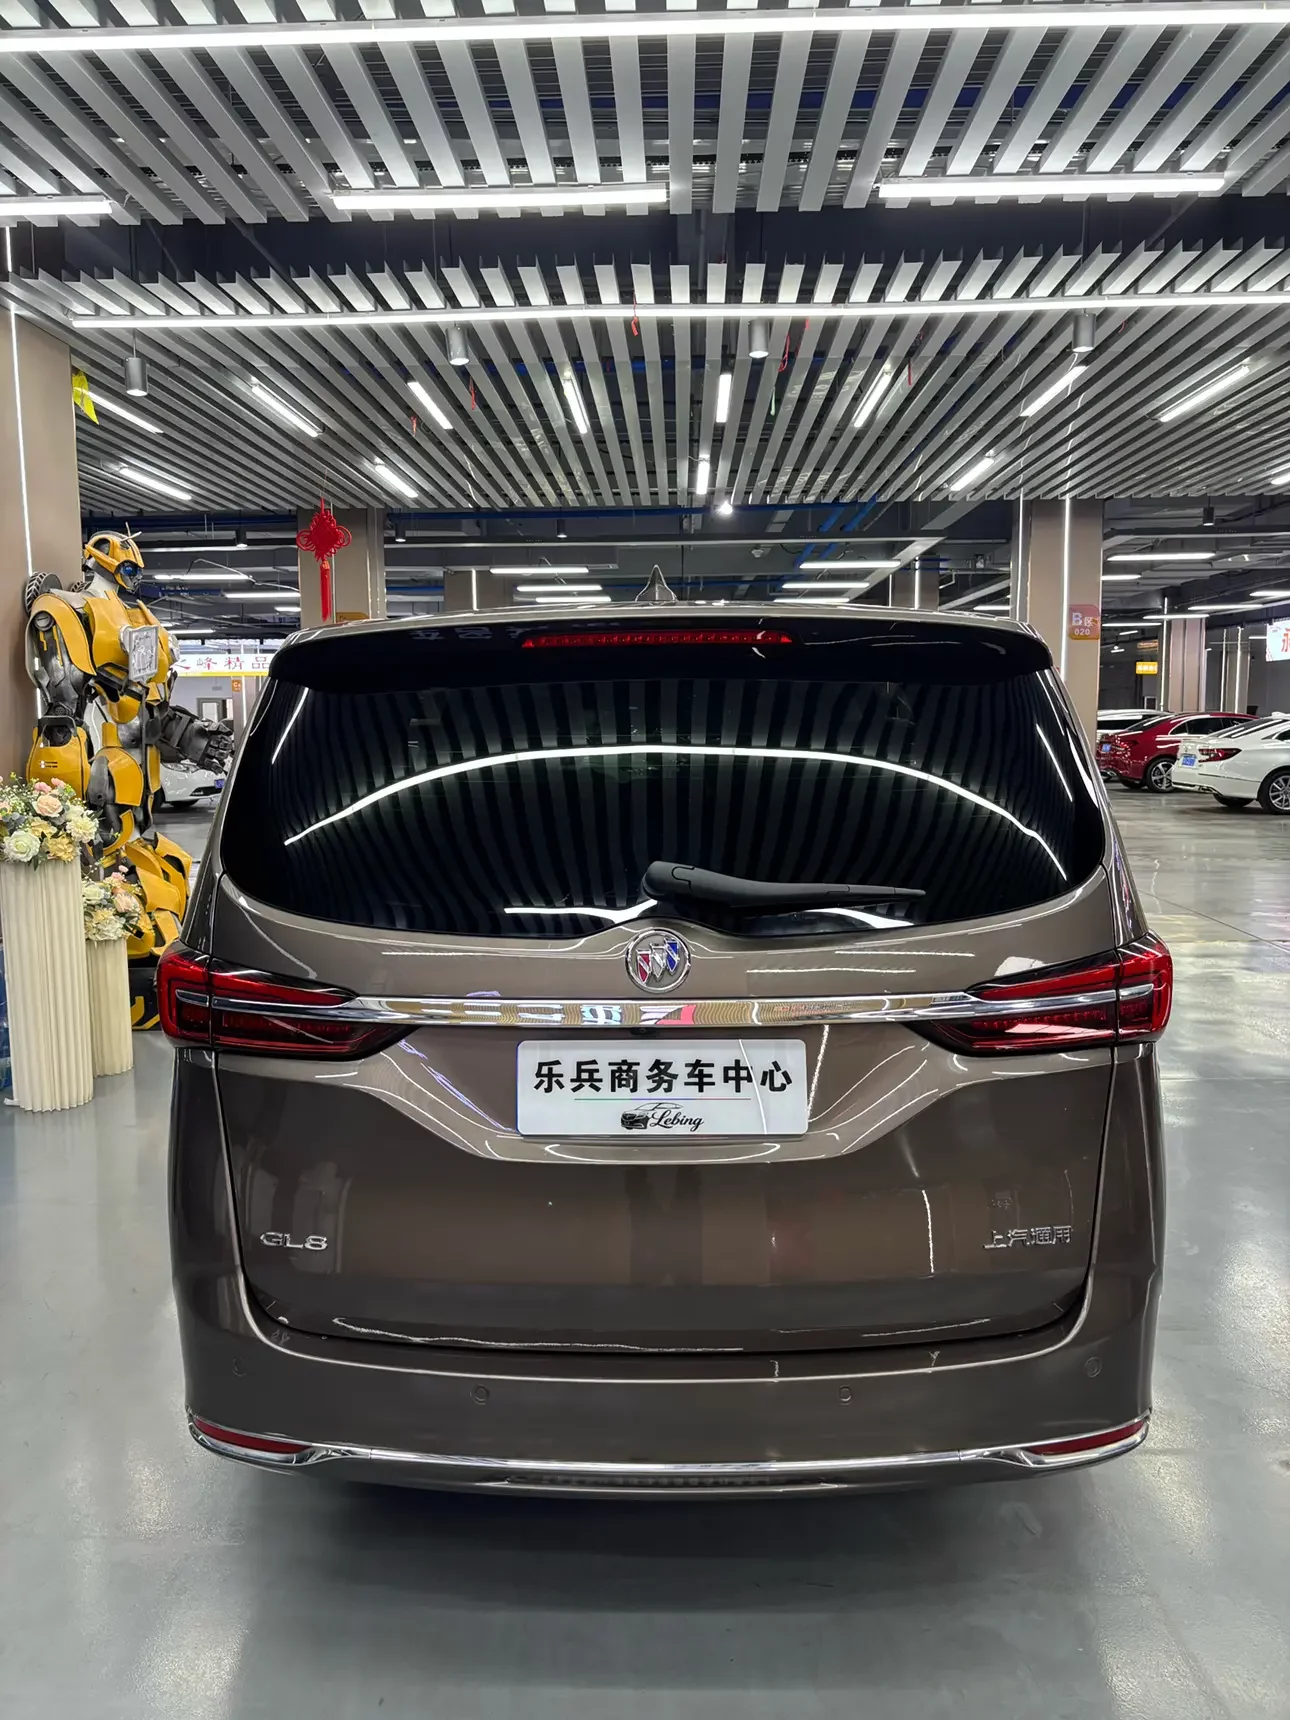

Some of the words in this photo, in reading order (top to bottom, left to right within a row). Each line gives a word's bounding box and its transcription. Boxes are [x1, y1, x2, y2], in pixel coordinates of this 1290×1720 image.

[1074, 628, 1091, 636] 020
[533, 1059, 793, 1094] 乐兵商务车中心
[649, 1109, 705, 1132] Lebing
[260, 1231, 328, 1251] GL8
[983, 1225, 1073, 1249] 上汽通用
